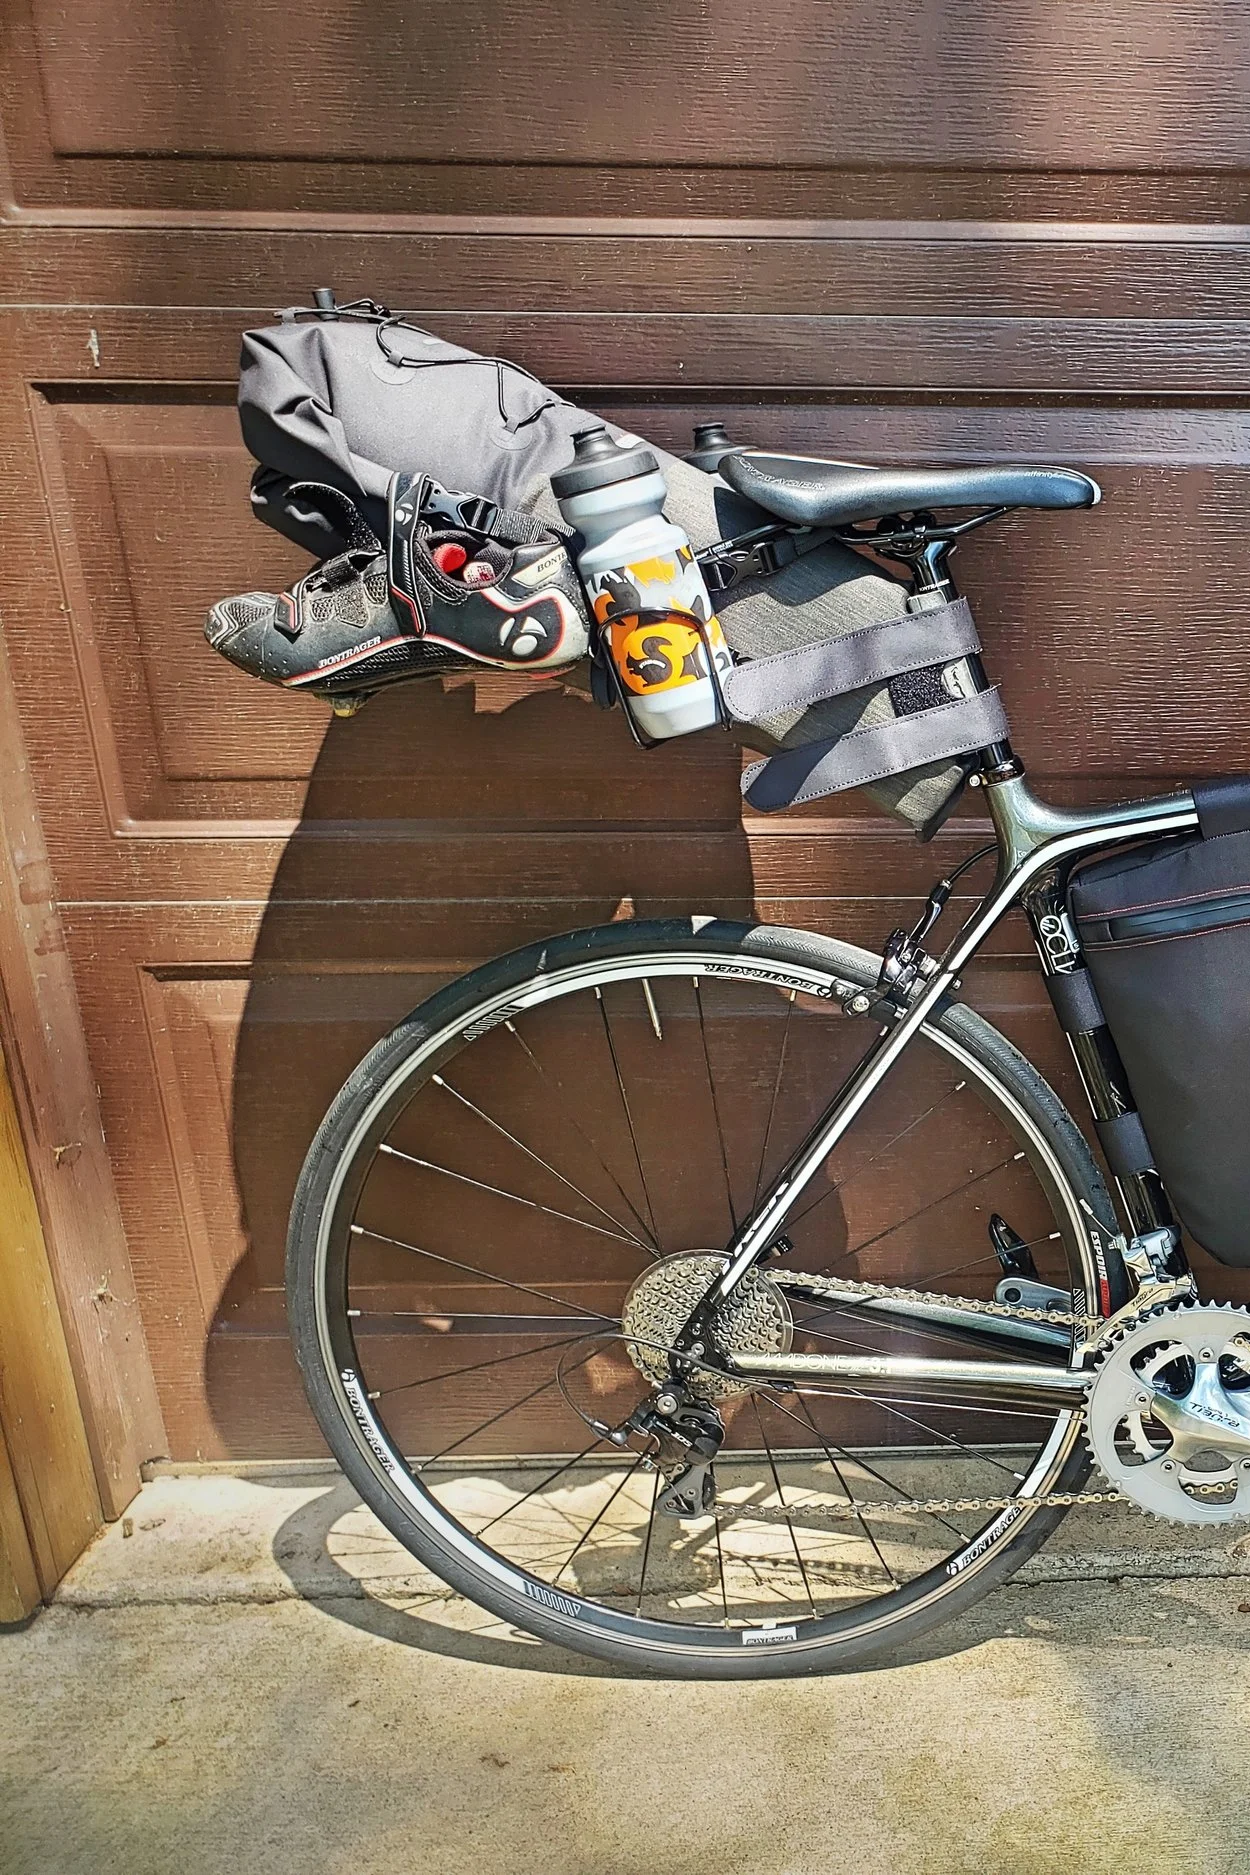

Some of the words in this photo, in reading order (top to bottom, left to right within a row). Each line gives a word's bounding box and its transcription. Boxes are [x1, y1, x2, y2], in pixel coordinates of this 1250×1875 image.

[318, 635, 382, 669] BONTRAGER
[704, 964, 813, 990] BONTRAGER
[1090, 1231, 1108, 1280] ESPOIR
[346, 1387, 396, 1473] BONTRAGER
[961, 1506, 1021, 1569] BONTRAGE
